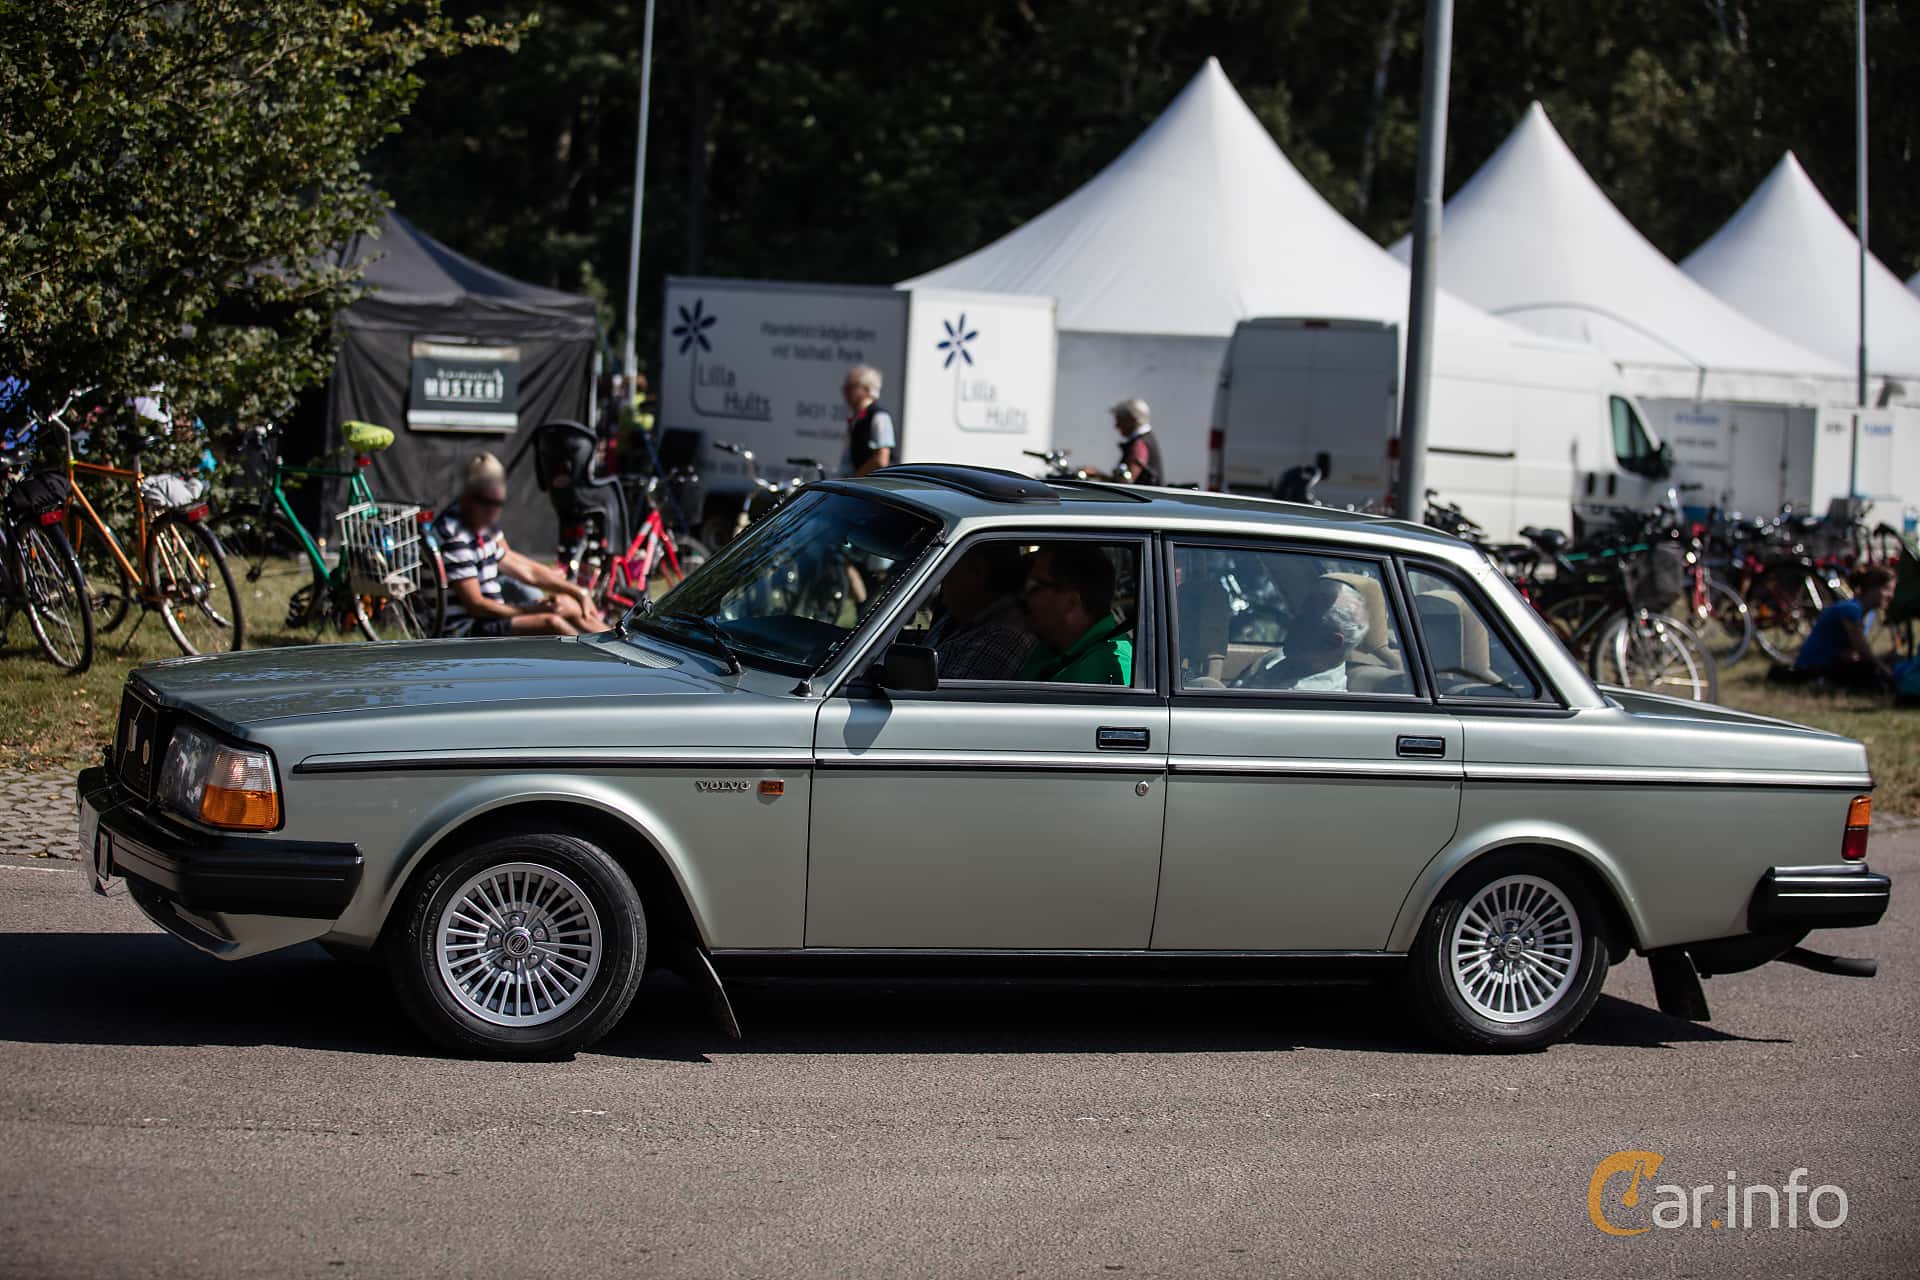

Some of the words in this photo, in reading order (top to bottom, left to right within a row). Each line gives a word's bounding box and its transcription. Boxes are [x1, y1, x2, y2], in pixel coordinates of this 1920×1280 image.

[699, 364, 735, 387] Lilla
[962, 379, 997, 402] Lilla
[724, 392, 771, 417] Hults
[696, 780, 751, 792] VOLVO
